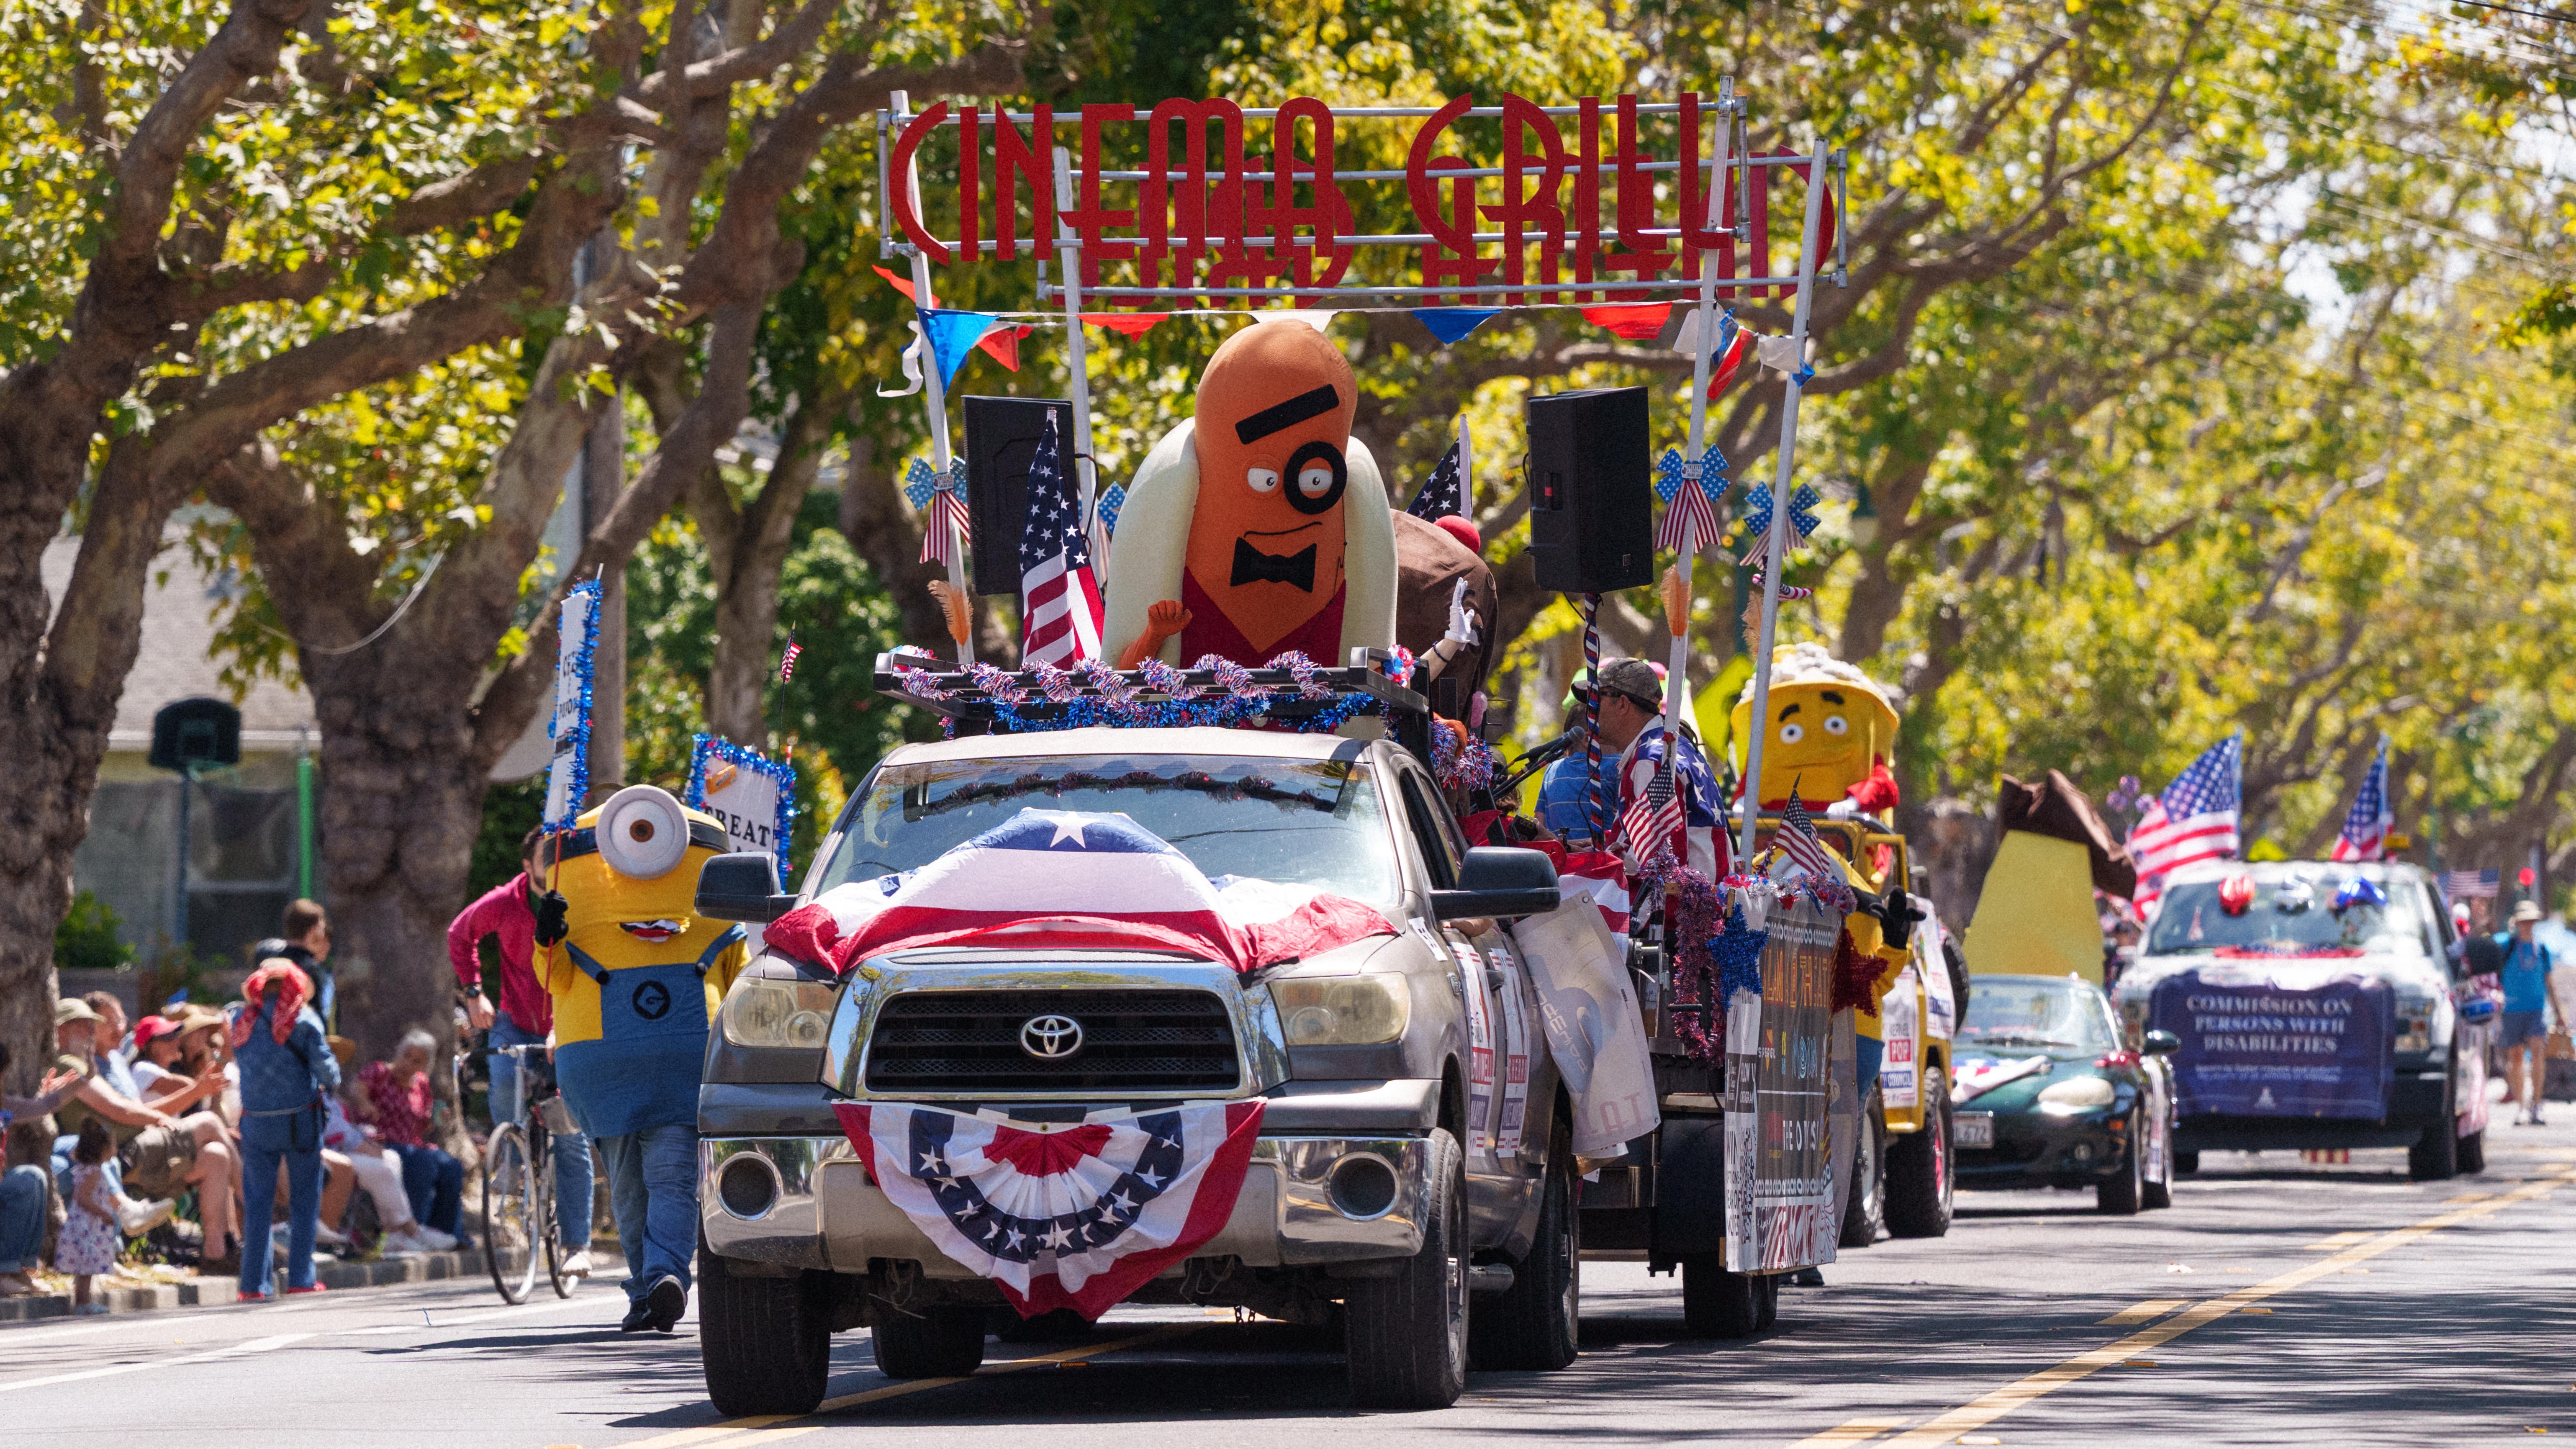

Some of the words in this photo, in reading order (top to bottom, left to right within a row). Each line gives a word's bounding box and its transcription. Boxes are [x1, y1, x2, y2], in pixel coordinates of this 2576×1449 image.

[889, 97, 1335, 267] CINEMA
[1406, 92, 1729, 259] GRILL
[2186, 994, 2319, 1015] COMMISSION
[2323, 998, 2352, 1015] ON
[2195, 1016, 2285, 1033] PERSONS
[2289, 1017, 2345, 1035] WITH
[1891, 1041, 1909, 1061] POP
[2204, 1035, 2338, 1054] DISABILITIES
[1888, 1072, 1912, 1087] COUNCIL
[1783, 1120, 1793, 1151] THE
[1727, 1131, 1738, 1164] WIN
